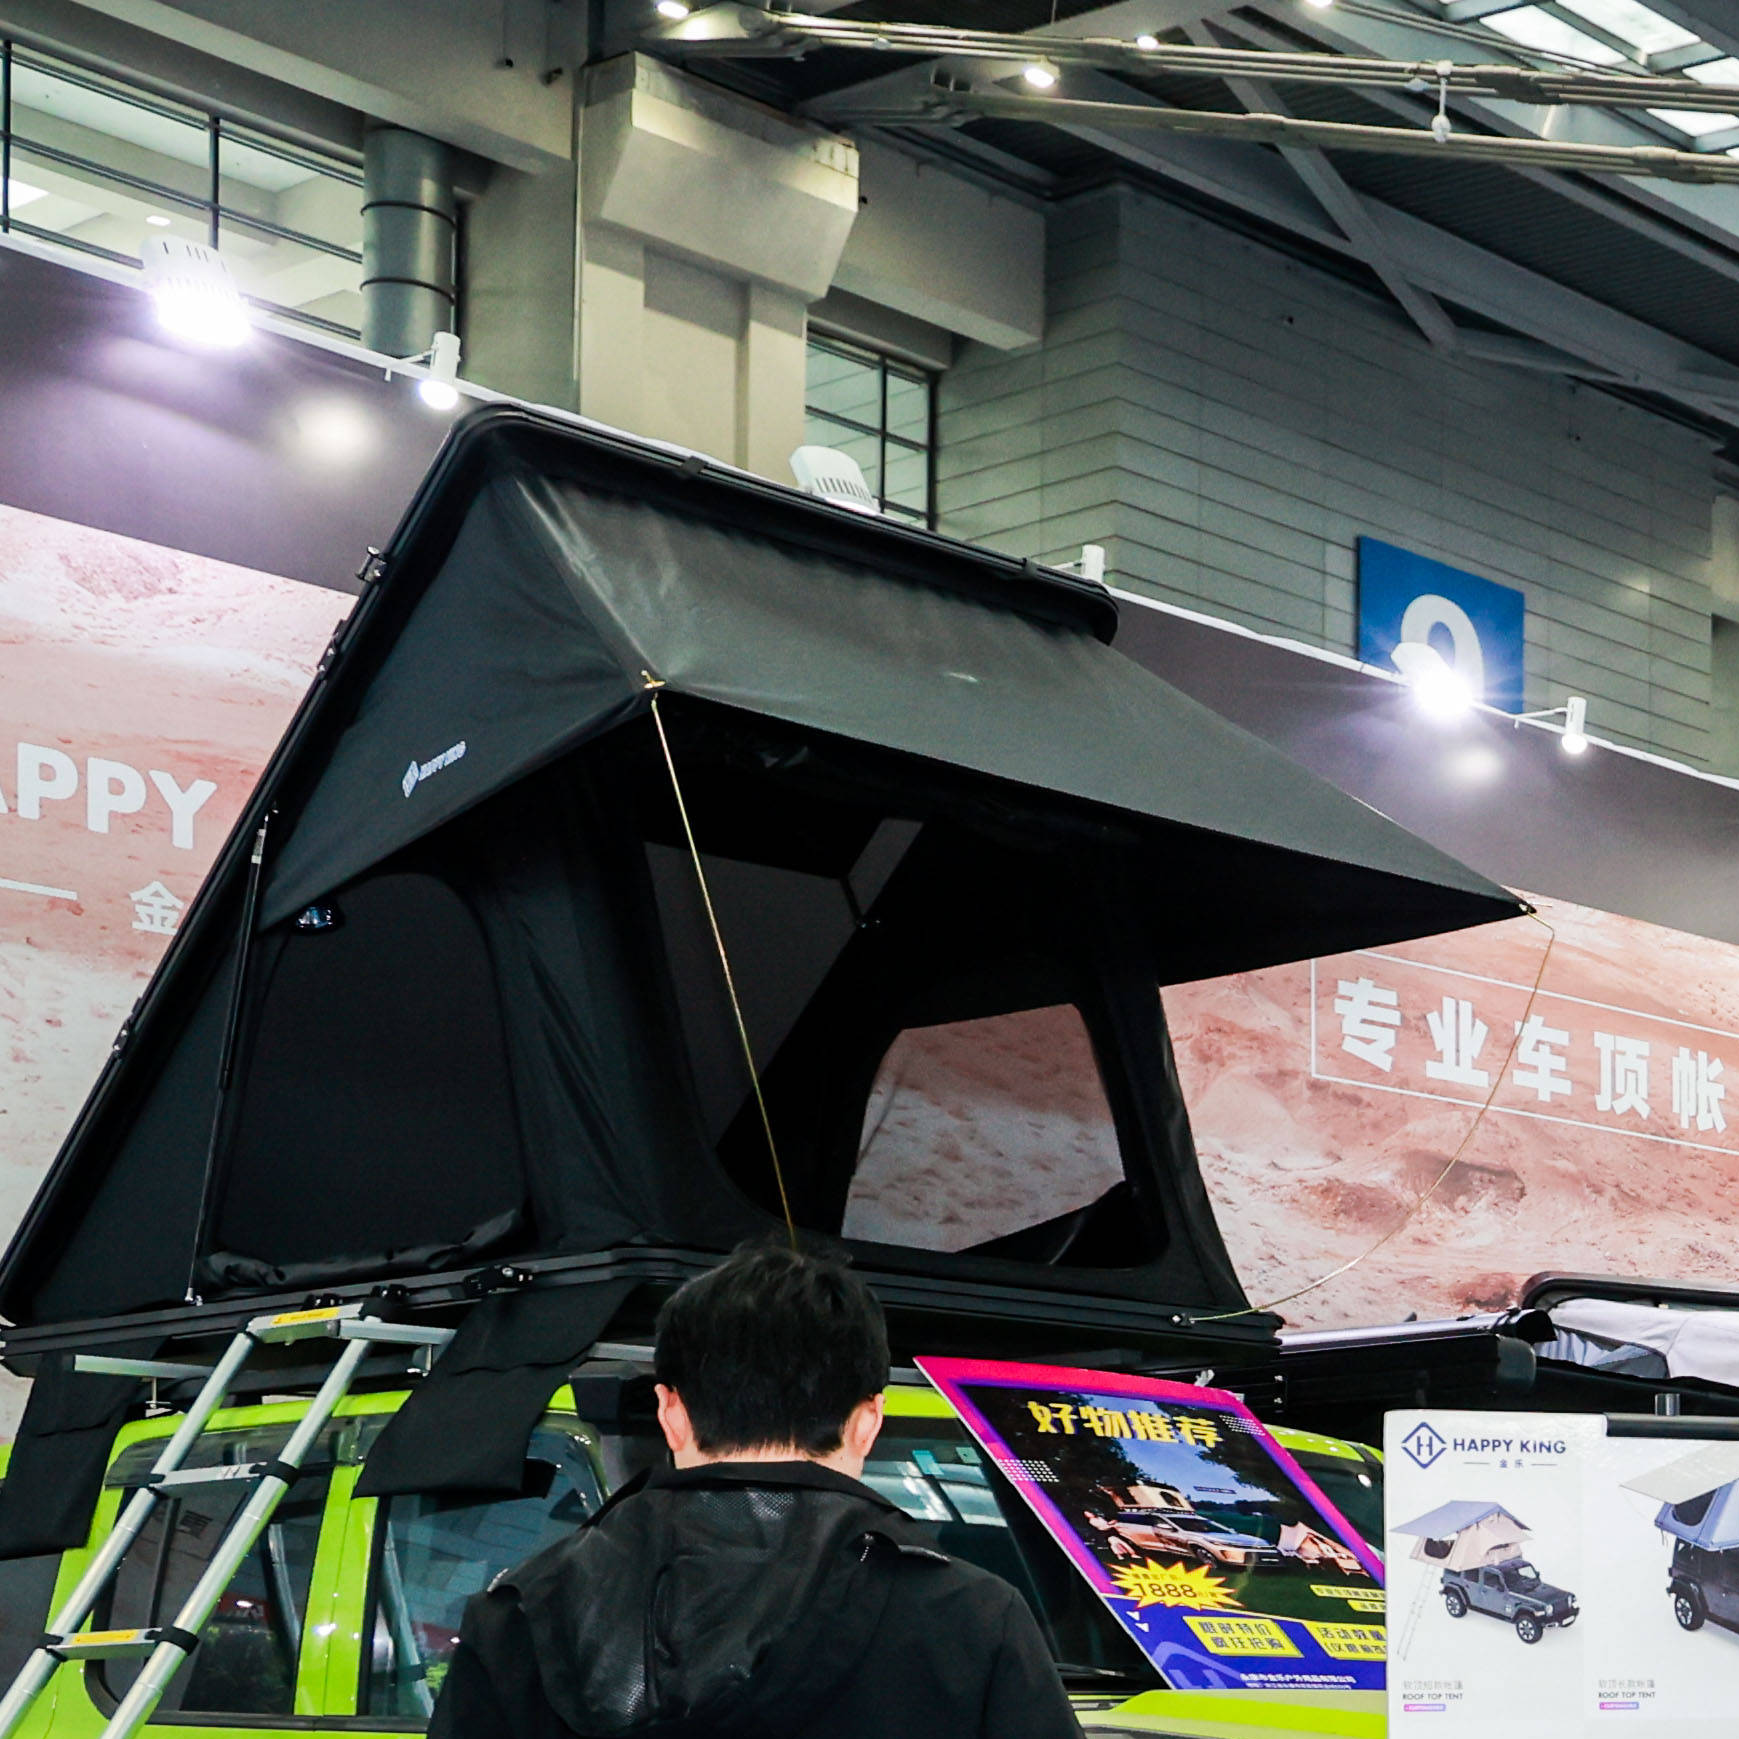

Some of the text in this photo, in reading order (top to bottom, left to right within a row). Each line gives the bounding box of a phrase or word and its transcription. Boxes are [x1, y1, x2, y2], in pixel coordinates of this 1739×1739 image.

[0, 742, 218, 850] PPY
[1027, 1400, 1224, 1448] 好物推荐
[1453, 1438, 1514, 1453] HAPPY
[1520, 1440, 1566, 1454] KING
[1134, 1583, 1197, 1598] 1888
[1445, 1692, 1464, 1700] TENT
[1598, 1691, 1656, 1699] ROOF TOP TENT
